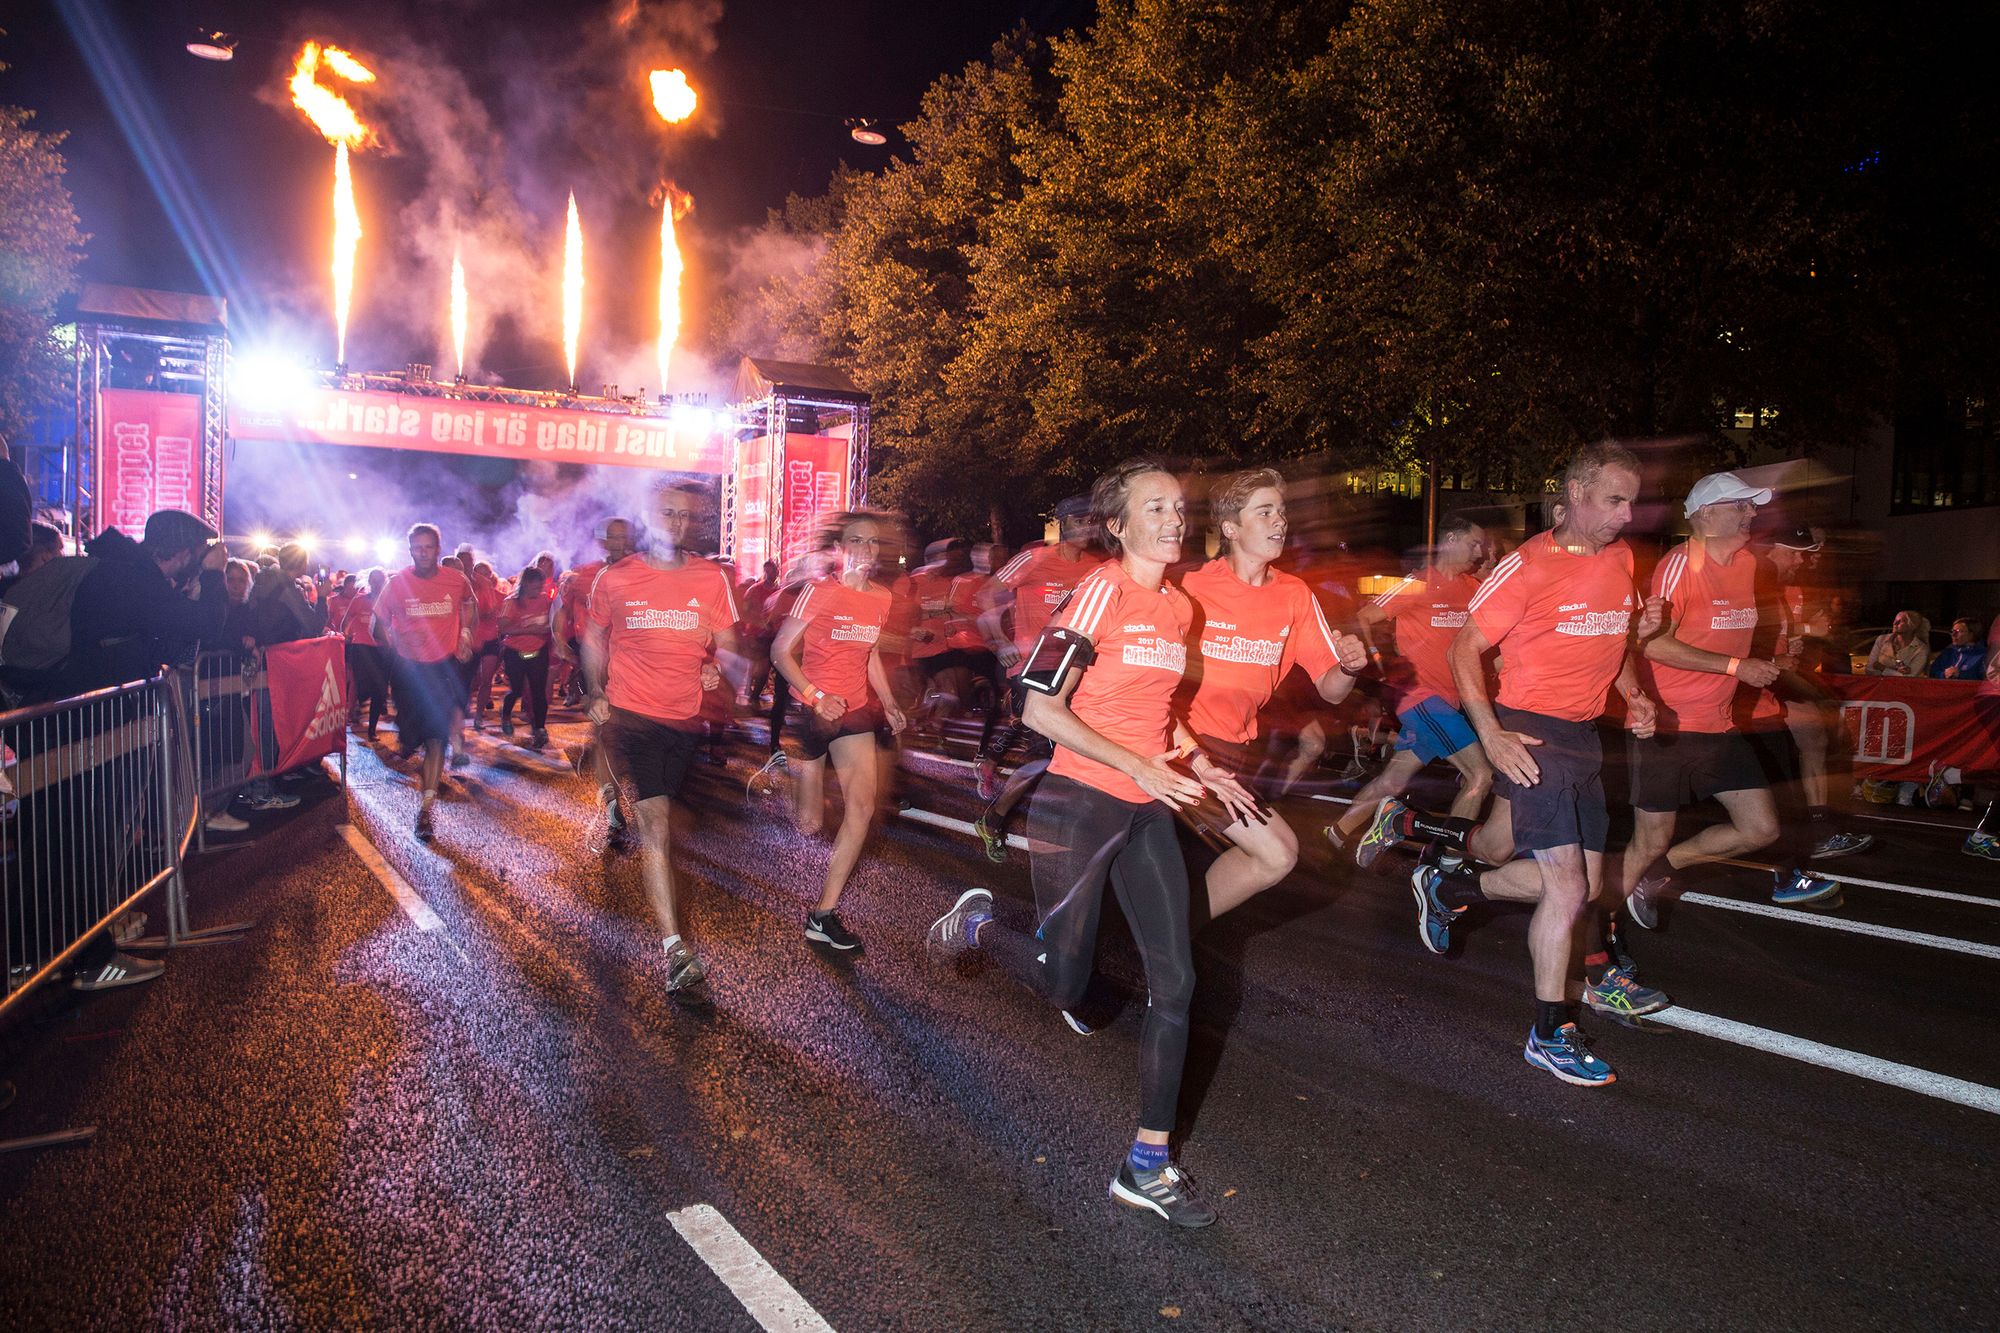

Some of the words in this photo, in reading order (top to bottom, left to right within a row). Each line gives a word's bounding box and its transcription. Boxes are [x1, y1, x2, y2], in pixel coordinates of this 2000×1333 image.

[1558, 602, 1587, 612] stadium
[645, 609, 699, 621] Stockholm
[625, 616, 699, 630] Midnattsloppet
[1123, 624, 1156, 632] stadium
[1205, 620, 1236, 631] stadium
